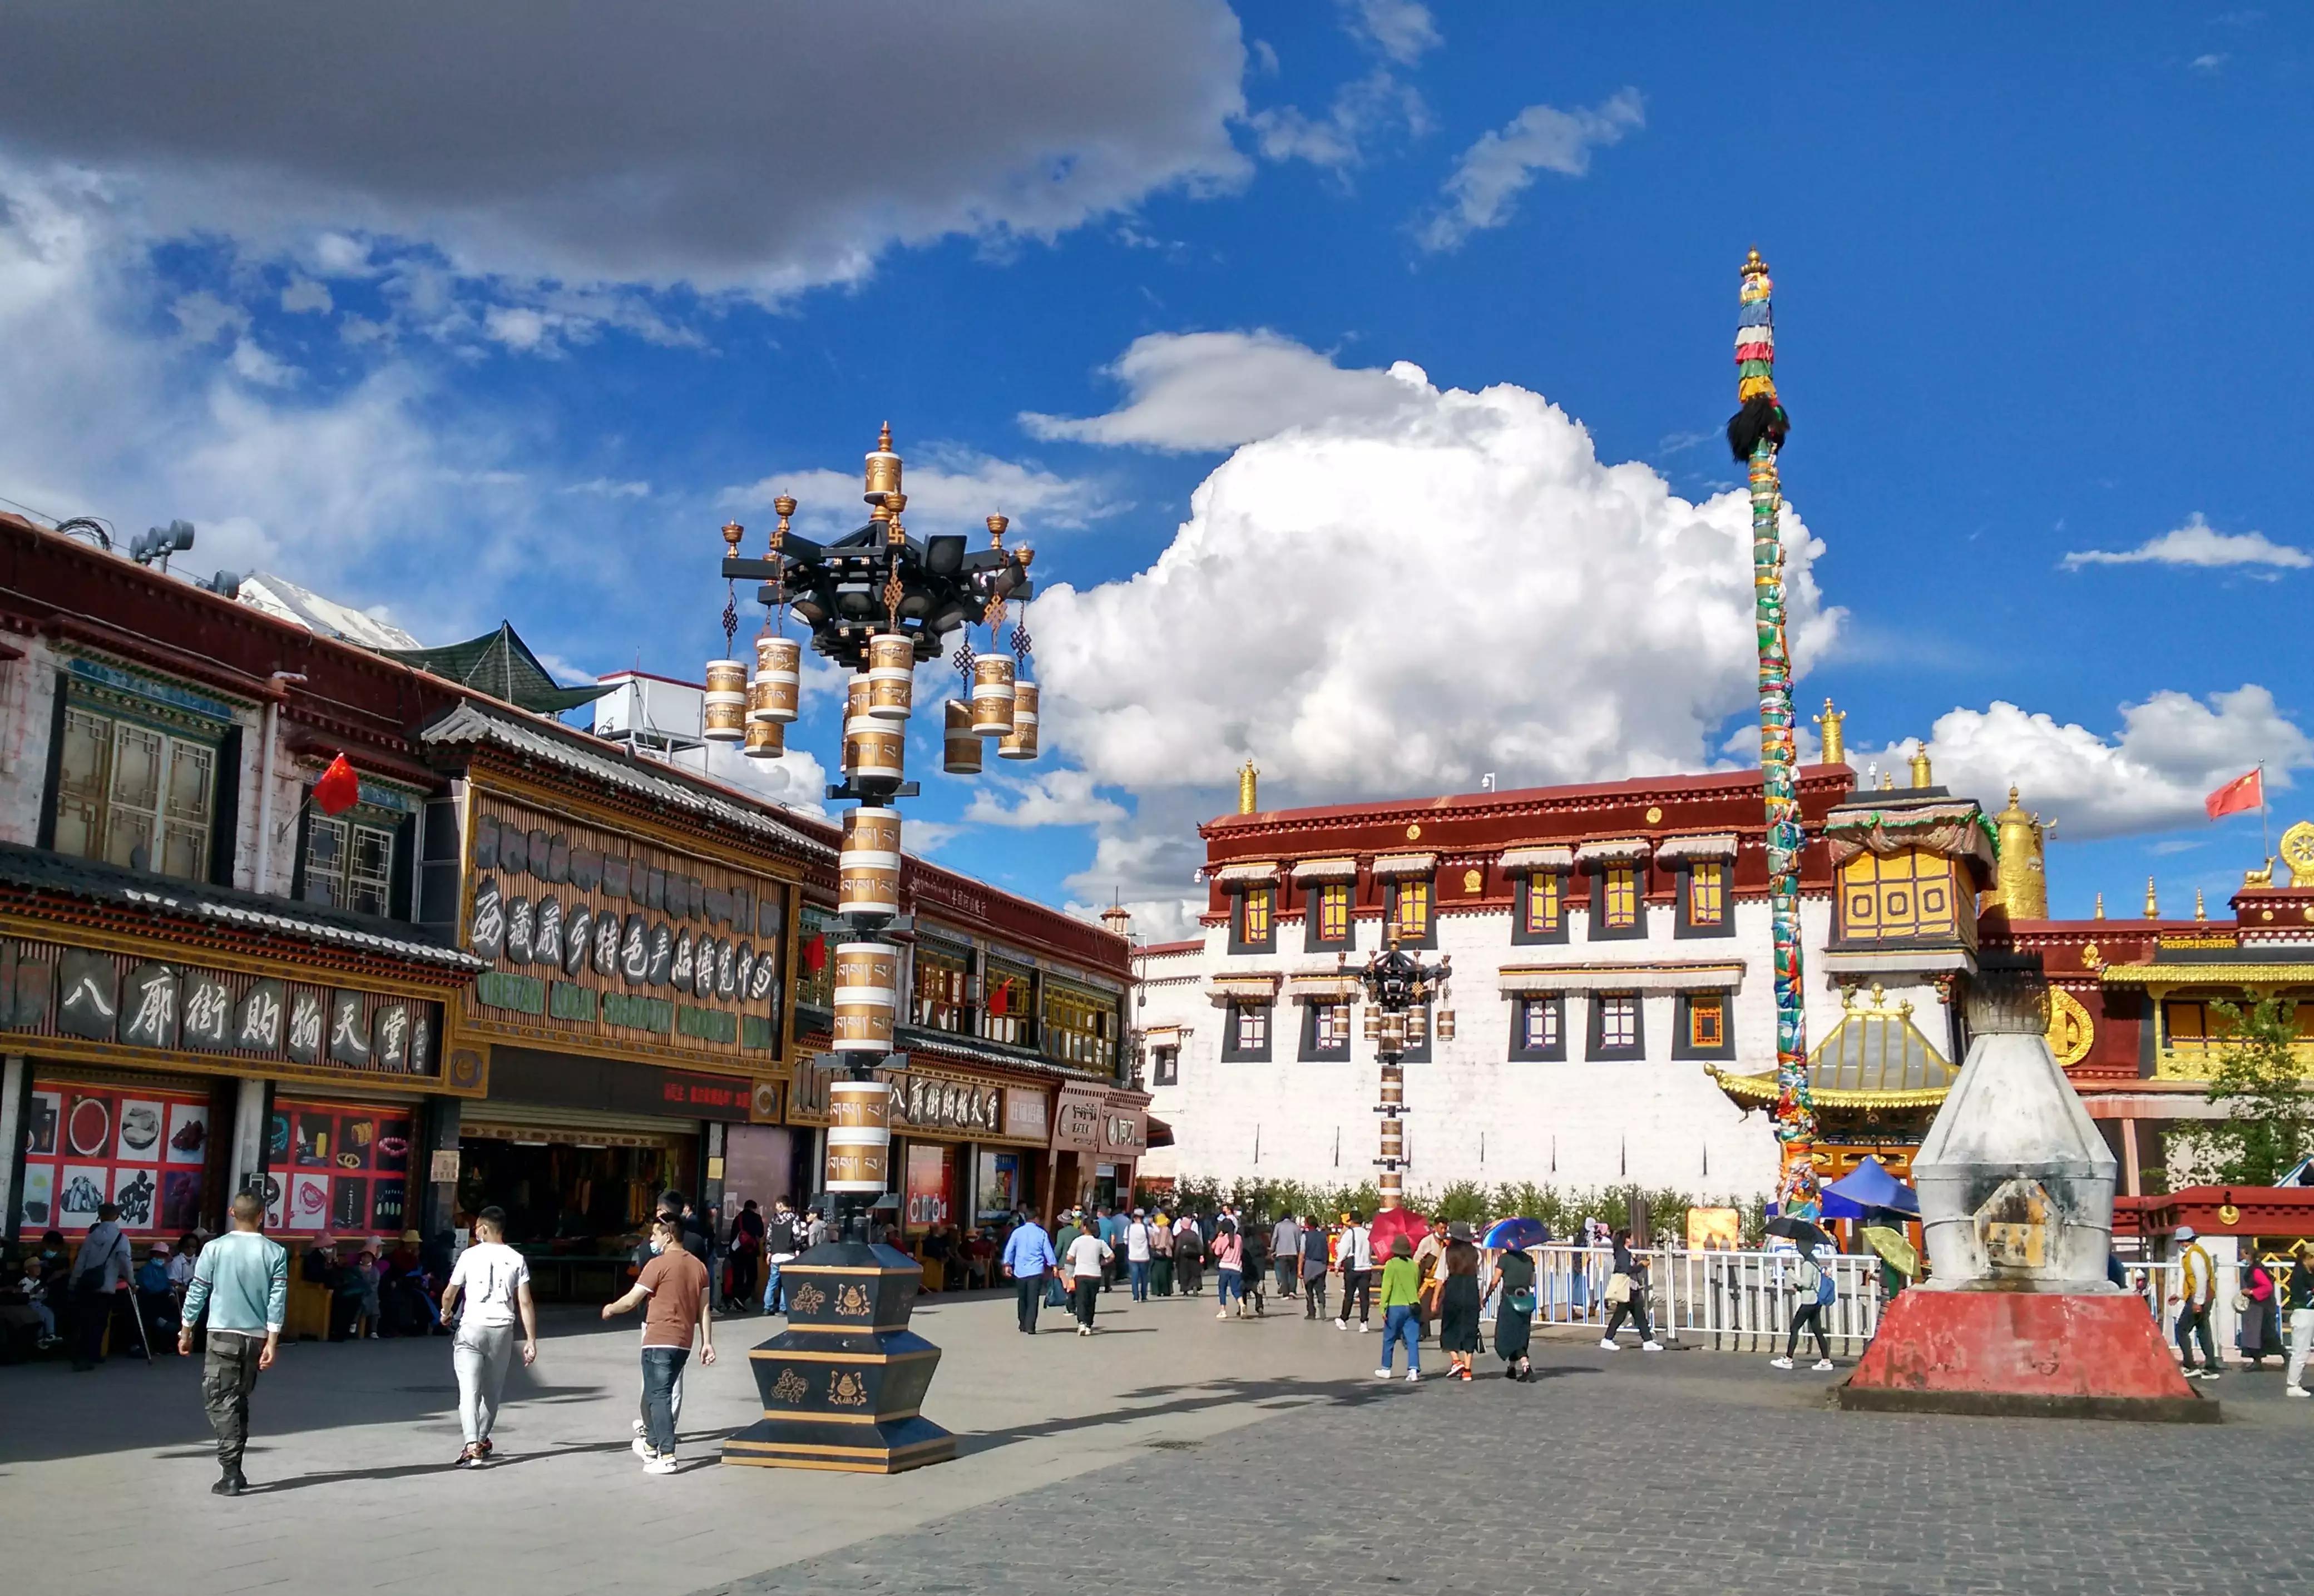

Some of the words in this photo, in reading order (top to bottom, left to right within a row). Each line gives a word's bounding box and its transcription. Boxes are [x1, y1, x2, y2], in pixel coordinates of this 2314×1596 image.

[65, 966, 407, 1060] 八廓街购物天堂
[889, 1077, 997, 1128] 八廓街购物天堂
